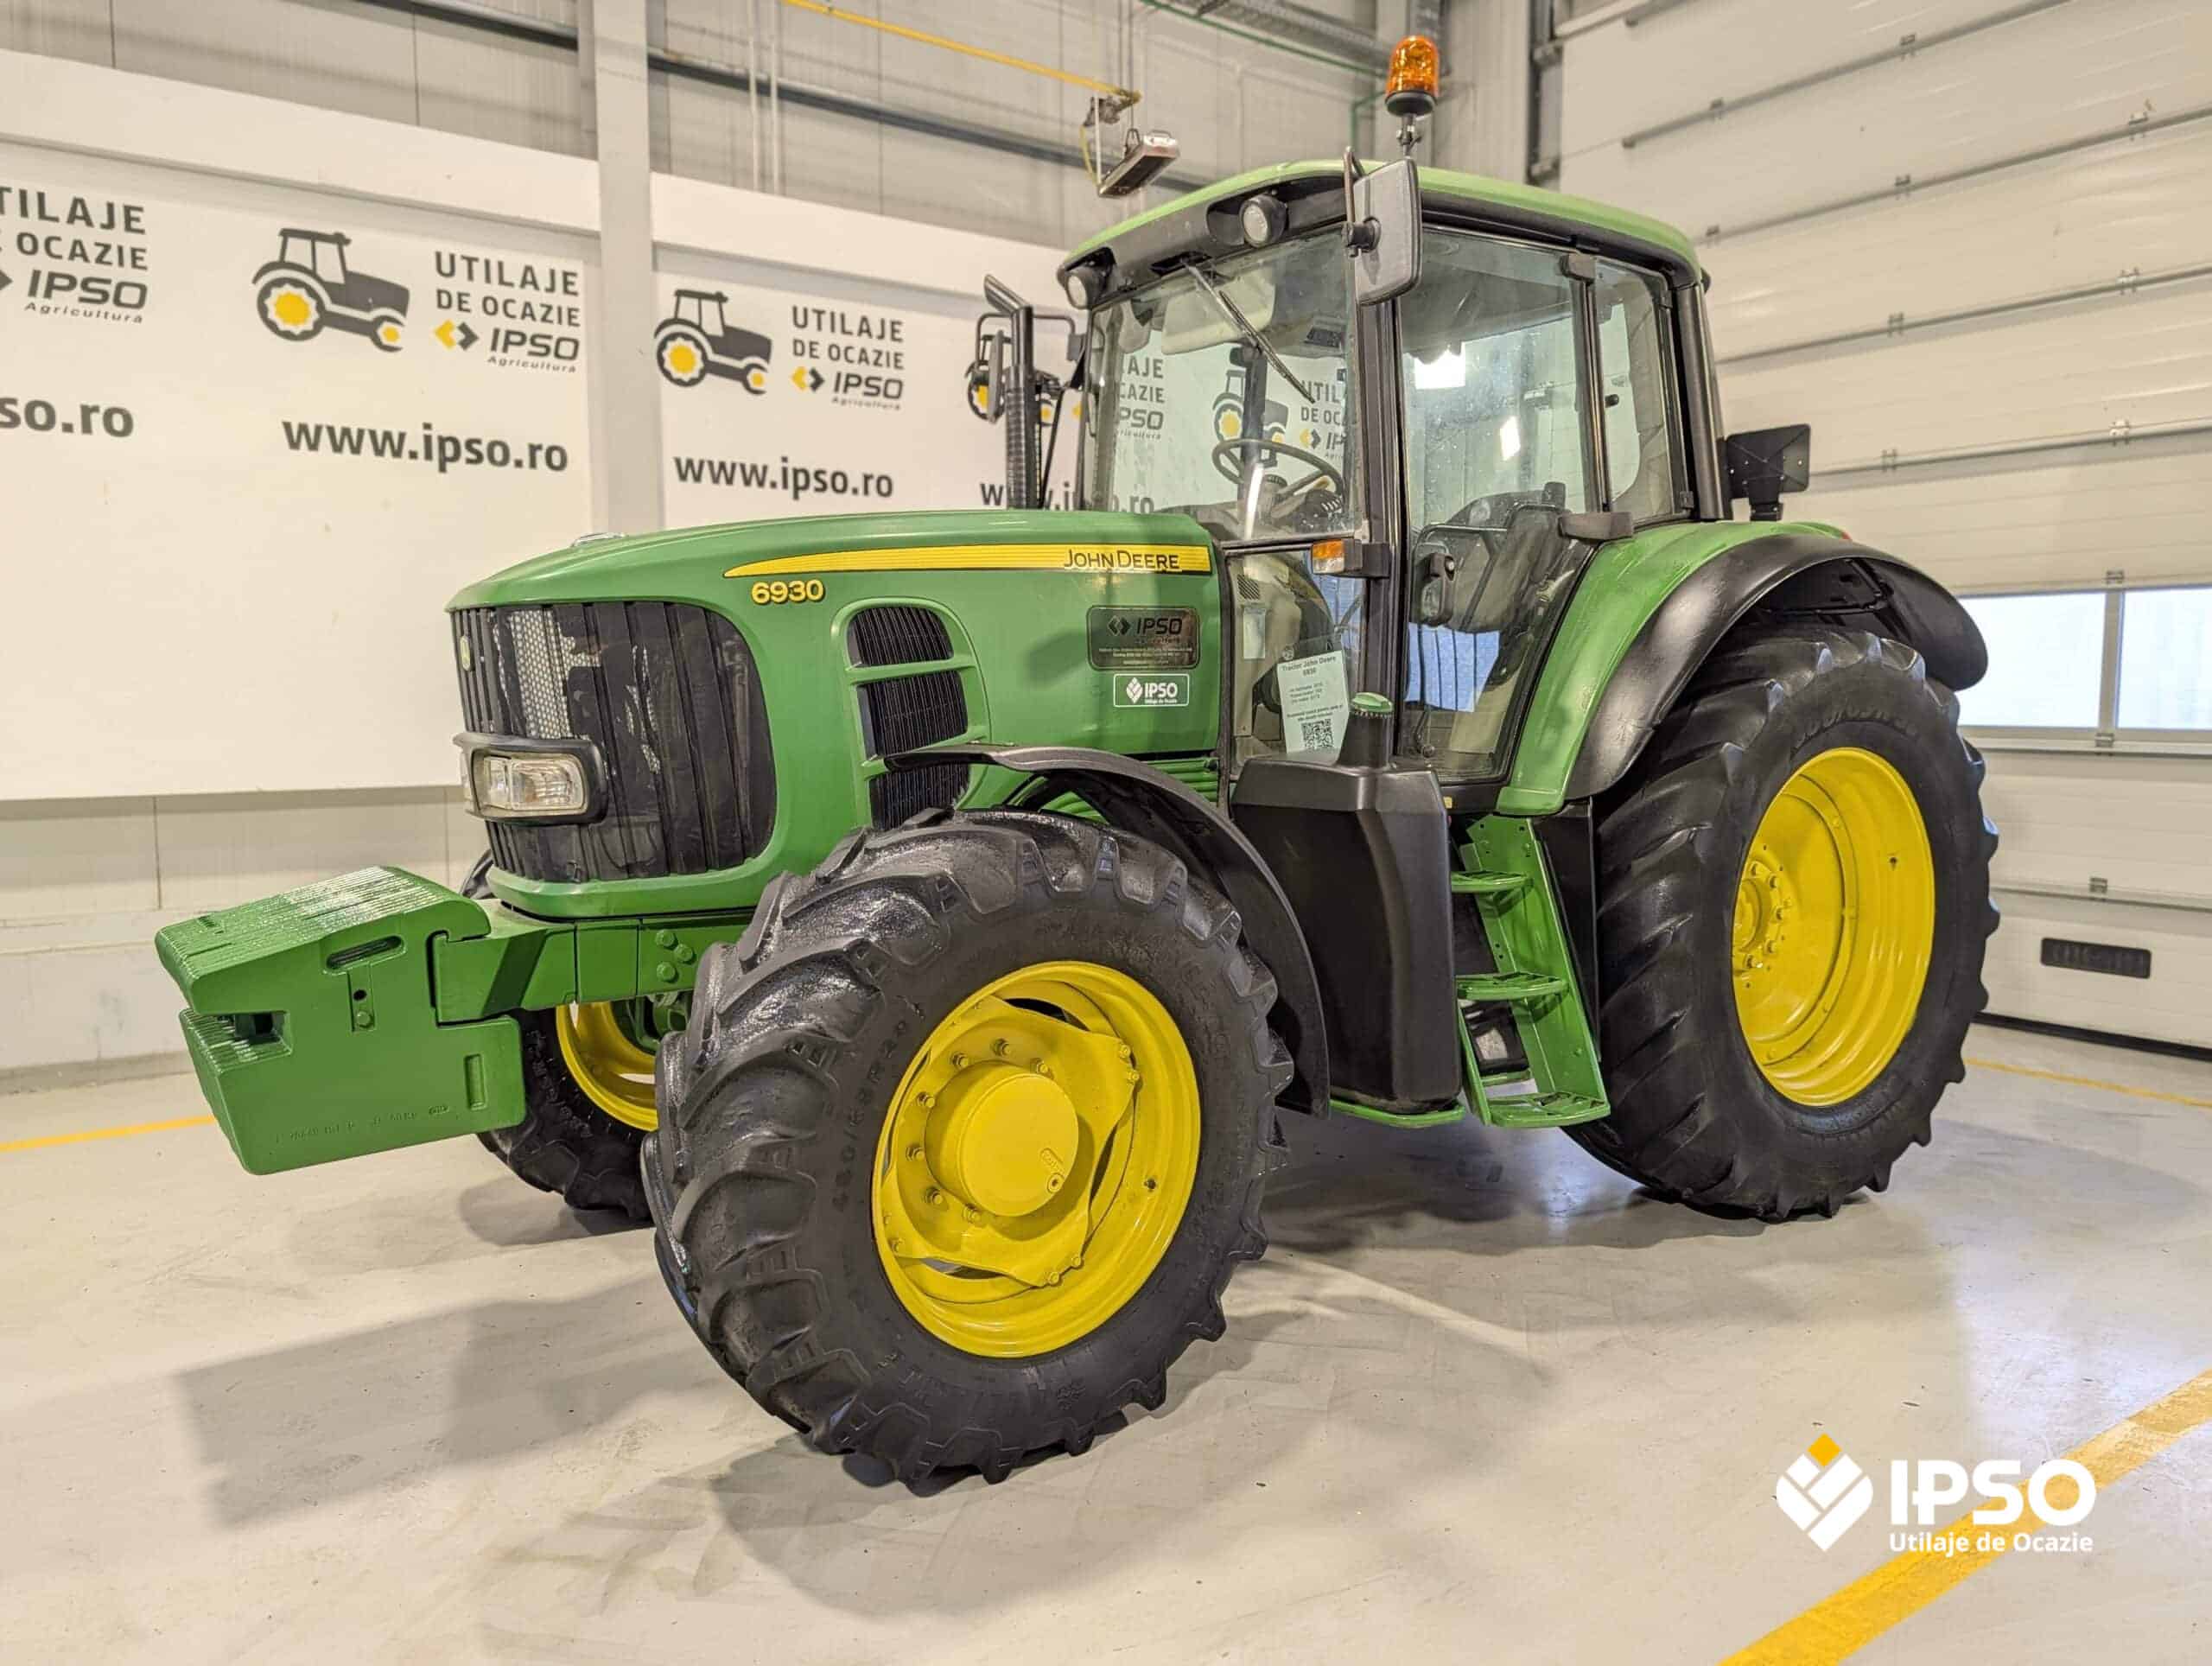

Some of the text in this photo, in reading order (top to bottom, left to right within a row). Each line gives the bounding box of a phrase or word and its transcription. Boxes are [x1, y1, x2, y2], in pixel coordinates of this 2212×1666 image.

[0, 186, 146, 235] TILAJE
[16, 232, 149, 270] OCAZIE
[28, 269, 148, 310] IPSO
[435, 251, 579, 296] UTILAJE
[435, 289, 582, 327] DE OCAZIE
[791, 305, 904, 343] UTILAJE
[490, 327, 580, 361] IPSO
[792, 339, 905, 370] DE OCAZIE
[832, 371, 904, 400] IPSO
[1121, 382, 1166, 404] AZIE
[1120, 407, 1164, 430] PSO
[1300, 406, 1319, 423] DE
[282, 421, 568, 474] www.ipso.ro
[673, 456, 893, 501] www.ipso.ro
[1064, 549, 1179, 569] JOHN DEERE
[751, 579, 826, 605] 6930
[1136, 617, 1183, 635] IPSO
[1144, 682, 1179, 698] IPSO
